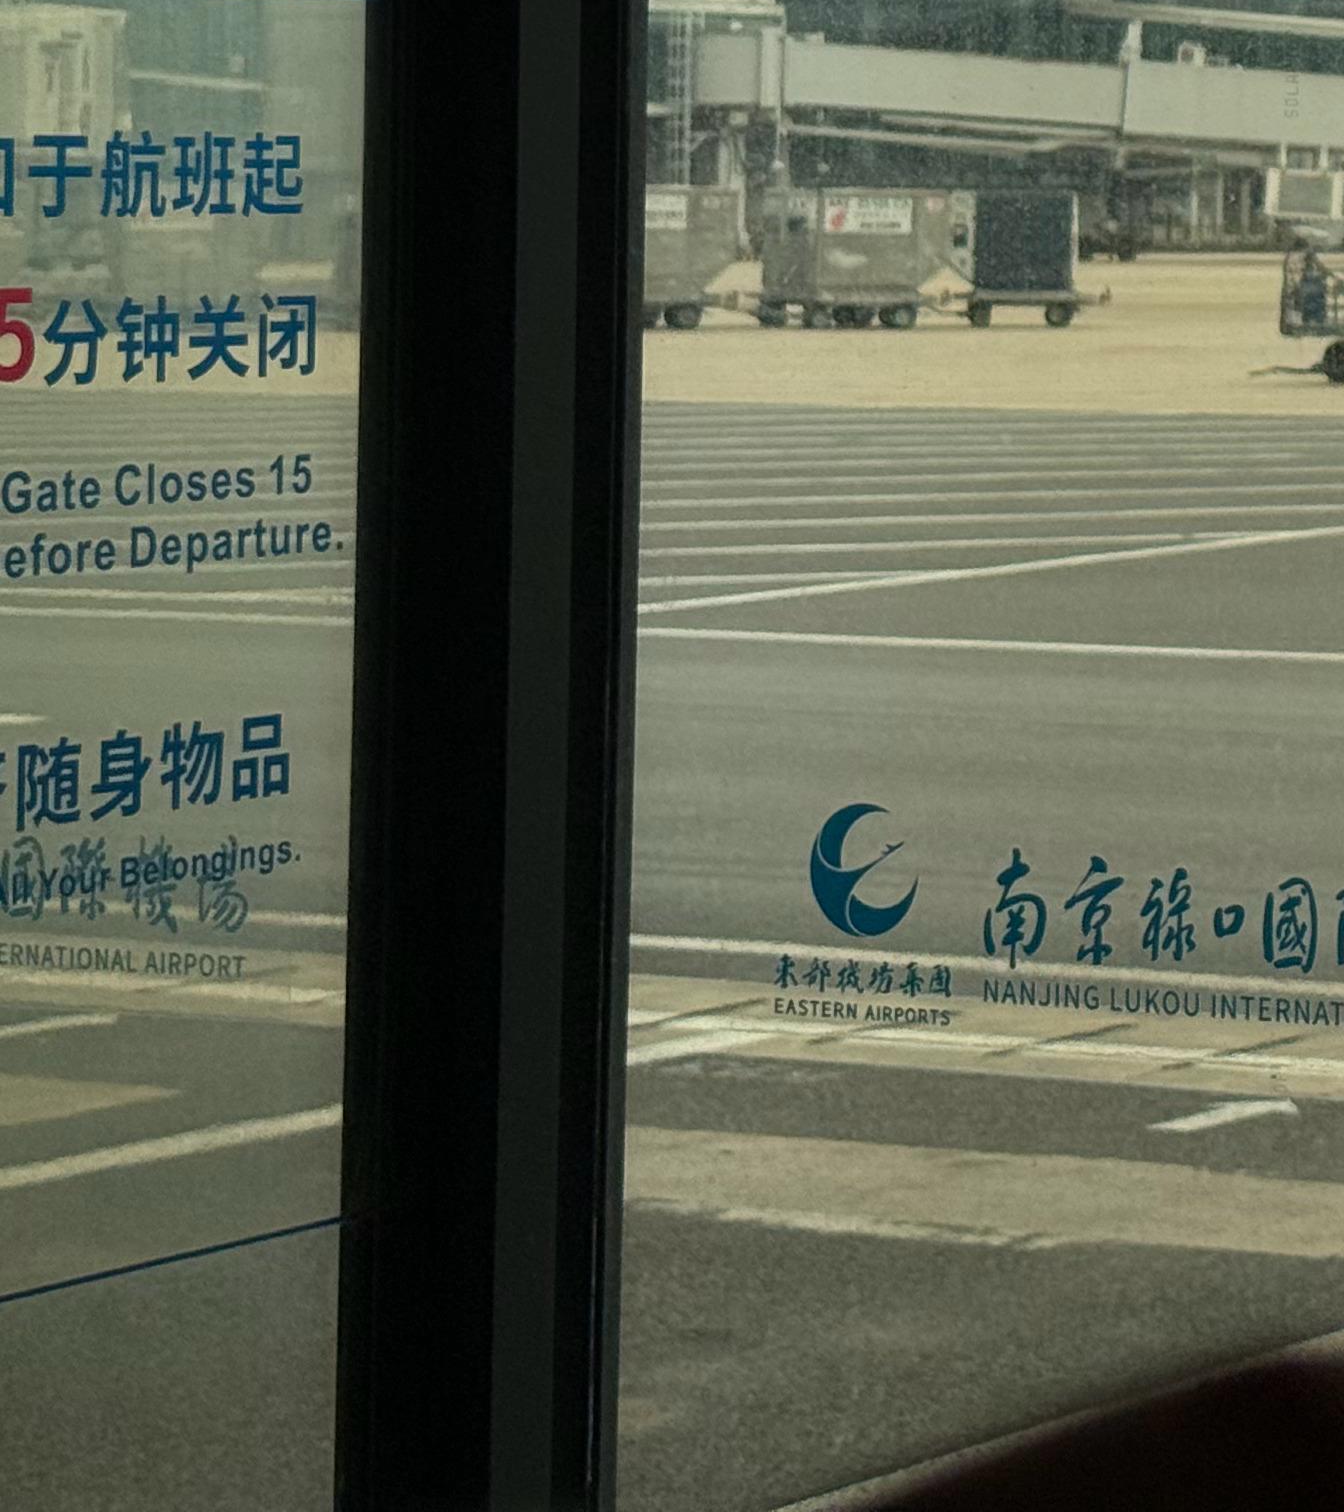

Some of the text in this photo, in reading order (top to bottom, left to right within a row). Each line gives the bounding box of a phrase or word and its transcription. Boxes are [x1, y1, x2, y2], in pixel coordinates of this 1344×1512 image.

[0, 130, 304, 217] 于航班起
[0, 287, 318, 387] 5分钟关闭
[2, 453, 312, 514] Gate Closes 15
[130, 518, 344, 574] Departure.
[0, 713, 290, 832] 随身物品
[39, 866, 111, 900] Your
[120, 840, 301, 889] Belongings.
[144, 950, 248, 979] AIRPORT
[773, 997, 952, 1027] EASTERN AIRPORTS
[983, 978, 1100, 1011] NANJING
[1110, 988, 1200, 1017] LUKOU
